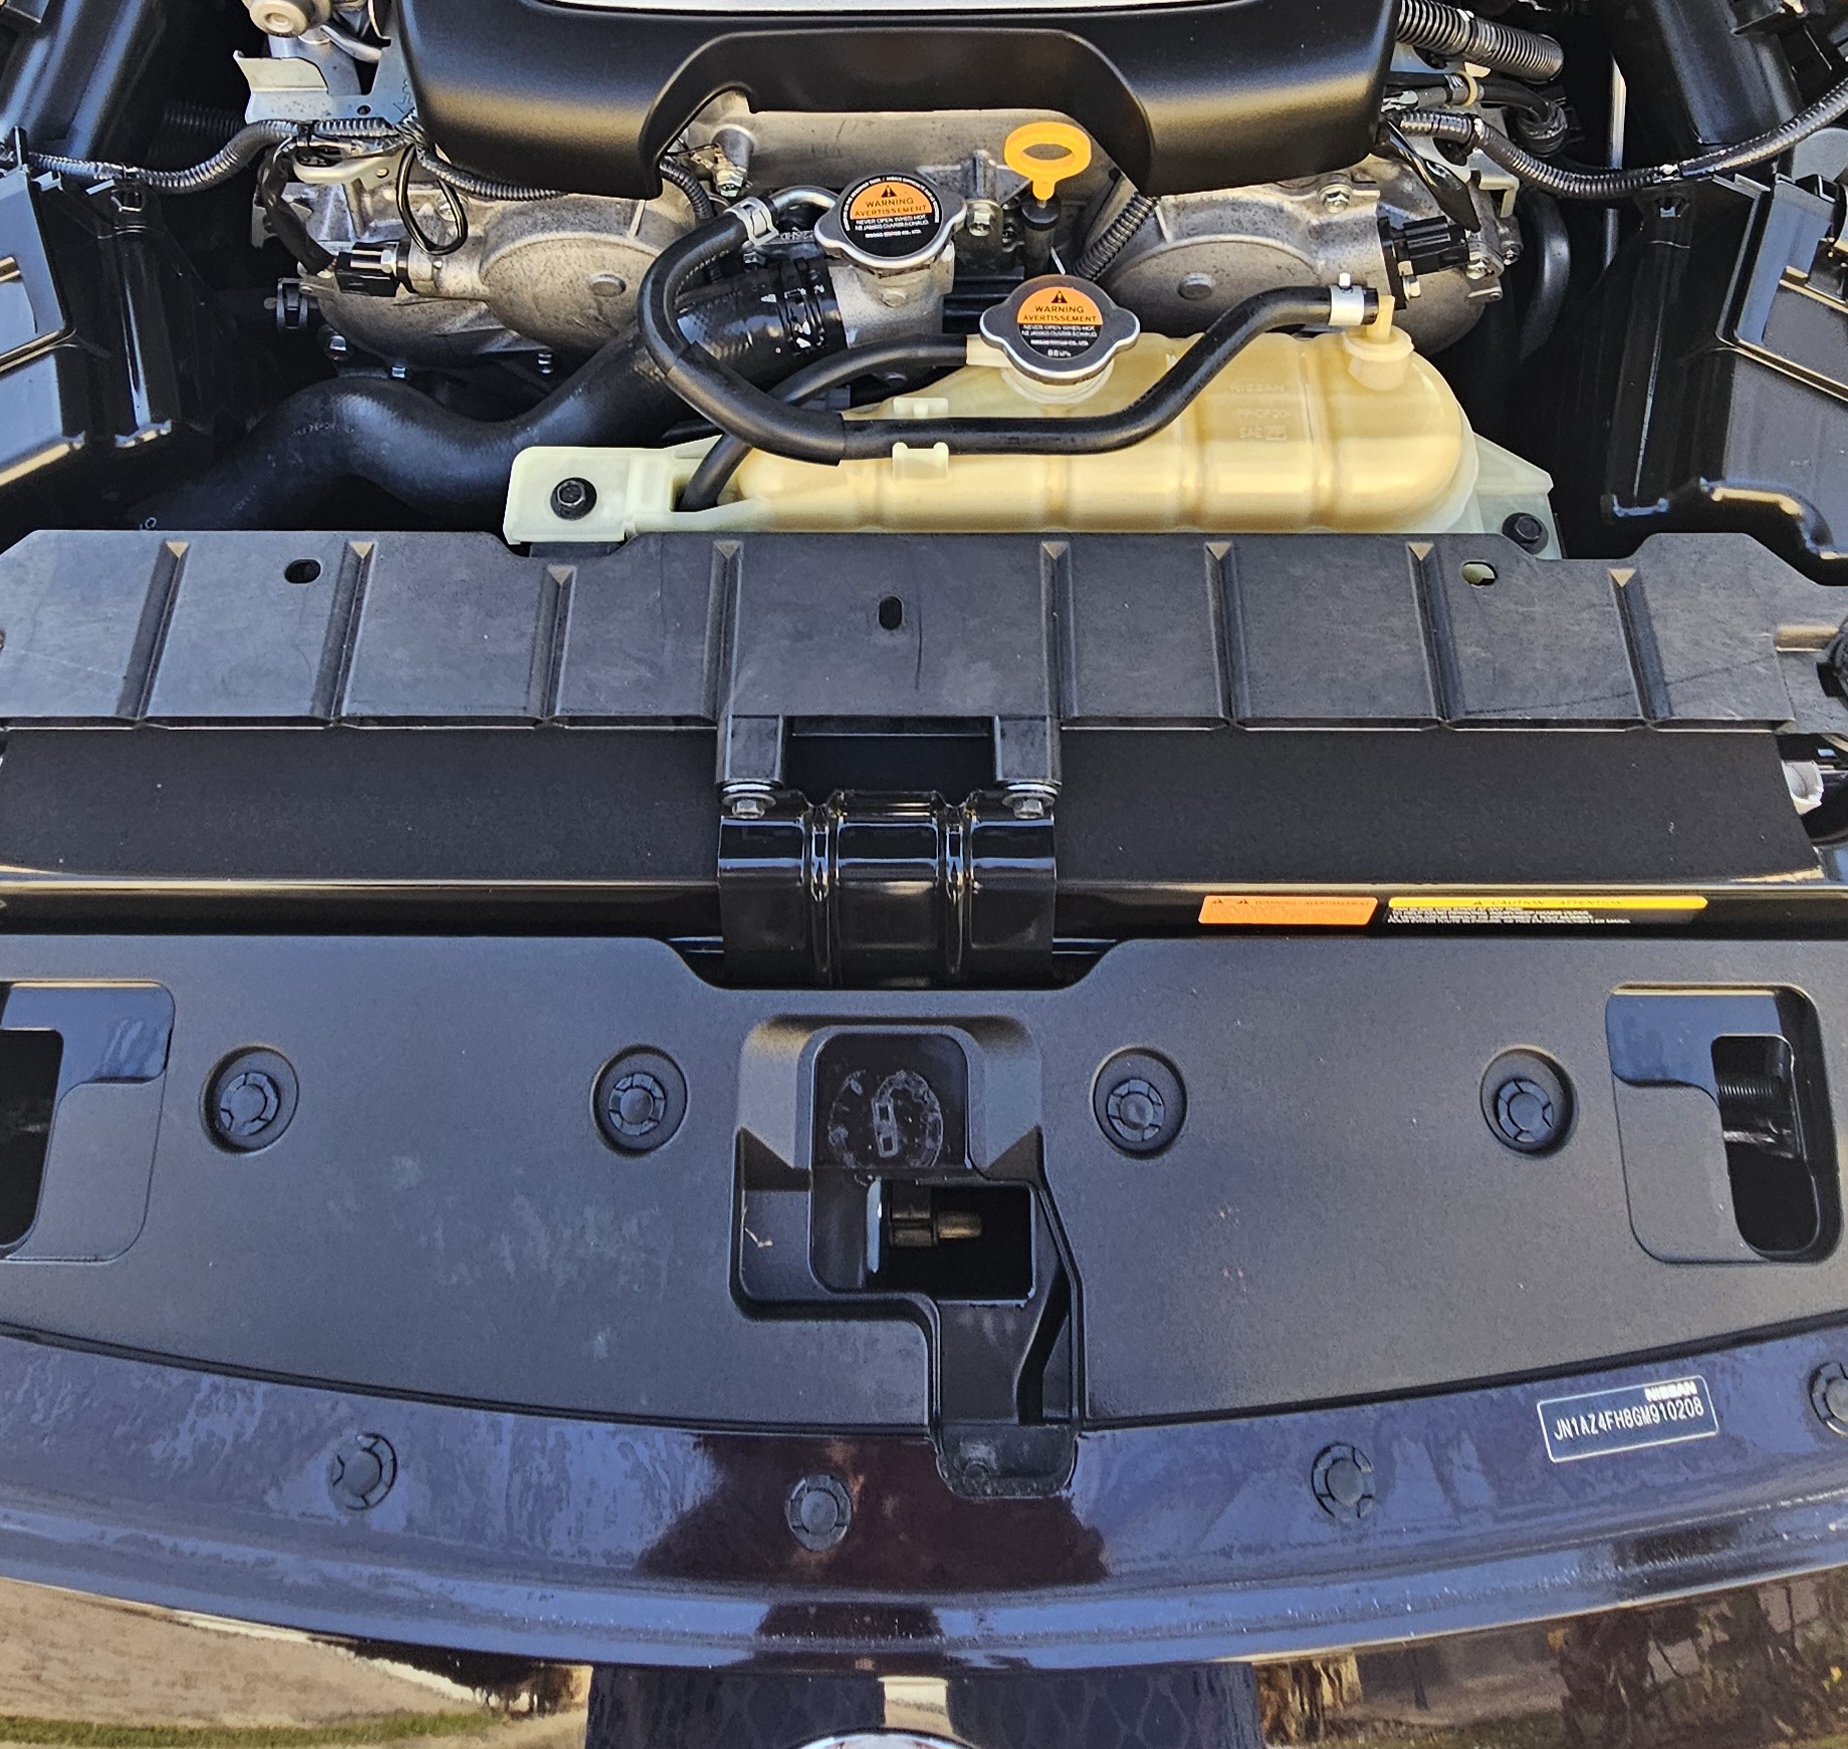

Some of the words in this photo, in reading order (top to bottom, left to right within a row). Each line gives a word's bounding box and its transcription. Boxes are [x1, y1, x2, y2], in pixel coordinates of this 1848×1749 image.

[865, 197, 914, 208] WARNING
[854, 204, 927, 217] AVERTISSEMENT
[1034, 305, 1084, 314] WARNING
[1023, 314, 1096, 322] AVERTISSEMENT
[1644, 1380, 1698, 1401] NISSAN
[1553, 1396, 1705, 1441] JN1AZ4FH8GM910208
